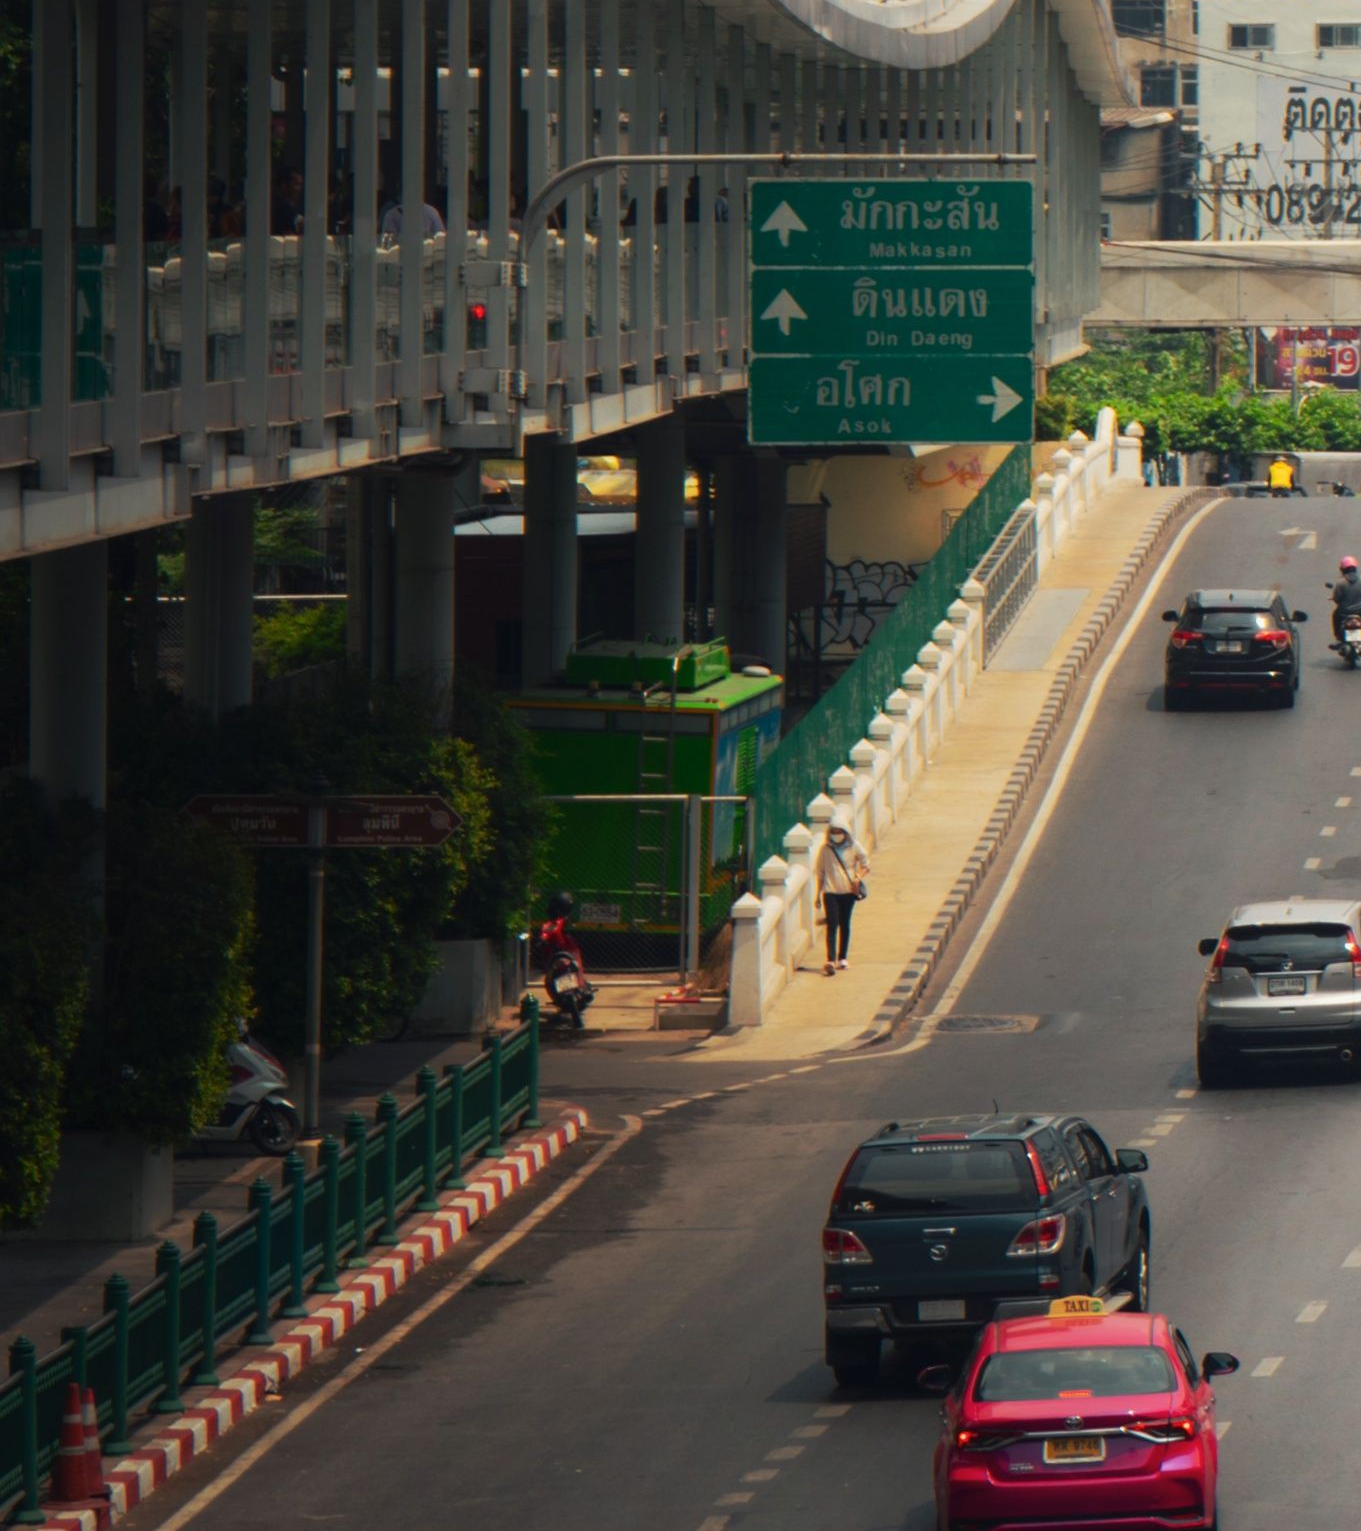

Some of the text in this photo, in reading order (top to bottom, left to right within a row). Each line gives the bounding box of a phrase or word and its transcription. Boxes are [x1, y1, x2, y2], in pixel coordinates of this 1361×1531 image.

[840, 185, 1000, 231] มักกะสัน
[869, 243, 972, 258] Makkasan
[852, 276, 988, 318] ดินแดง
[866, 330, 973, 350] Din Daeng
[815, 360, 912, 409] อโศก
[838, 419, 892, 434] Asok
[1064, 1300, 1090, 1313] TAXI
